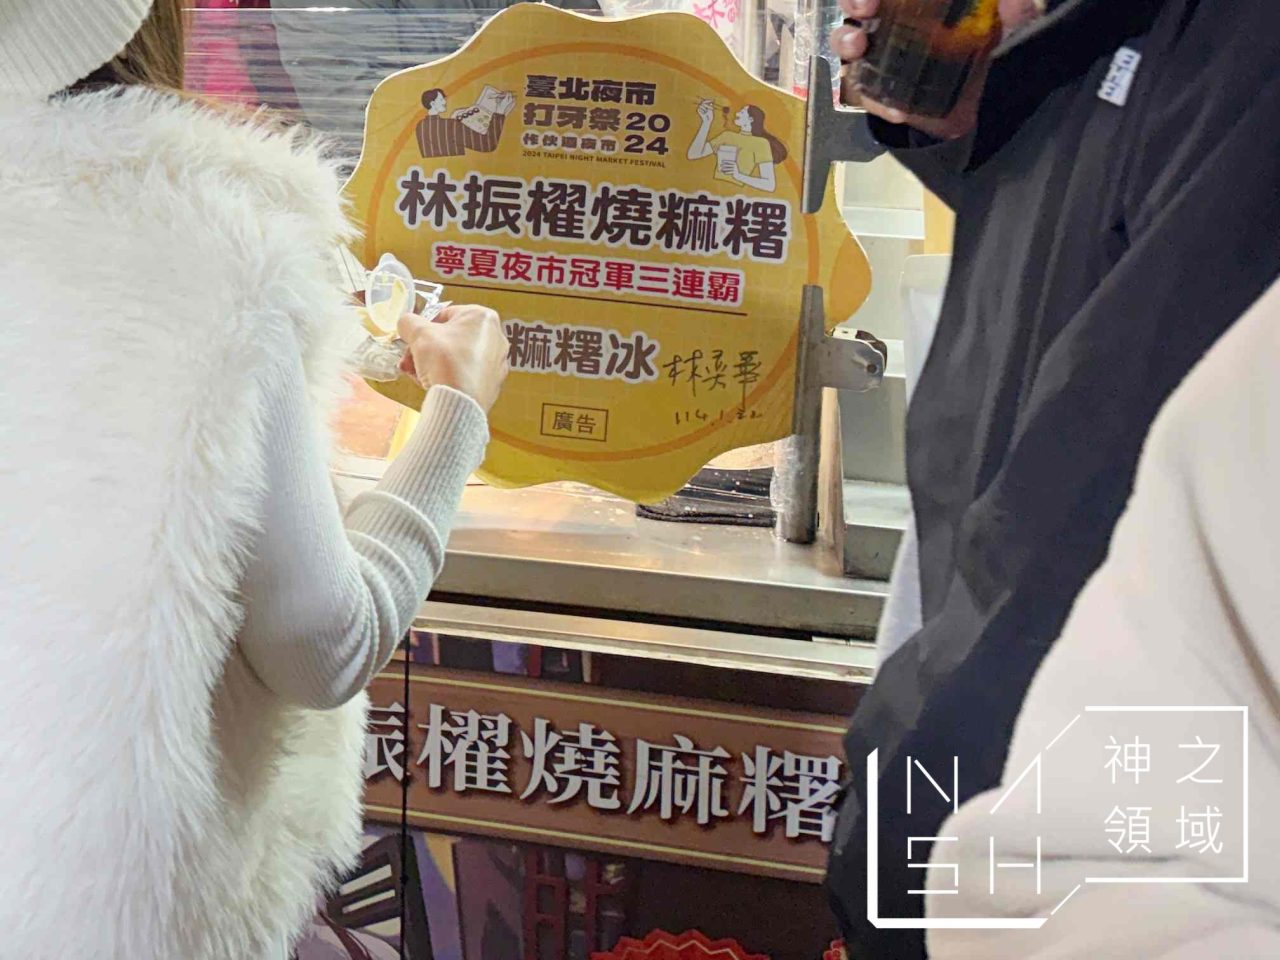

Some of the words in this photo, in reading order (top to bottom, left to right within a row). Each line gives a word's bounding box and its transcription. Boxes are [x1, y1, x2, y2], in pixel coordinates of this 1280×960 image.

[524, 74, 657, 105] 臺北夜市
[523, 102, 622, 131] 打牙祭
[625, 112, 671, 133] 20
[623, 134, 669, 155] 24
[522, 150, 541, 158] 2024
[543, 152, 568, 160] TAIPEI
[570, 154, 595, 162] NIGHT
[596, 156, 628, 165] MARKET
[629, 159, 666, 169] FESTIVAL
[434, 245, 741, 304] 寧夏夜市冠軍三連霸
[552, 411, 597, 435] 廣告
